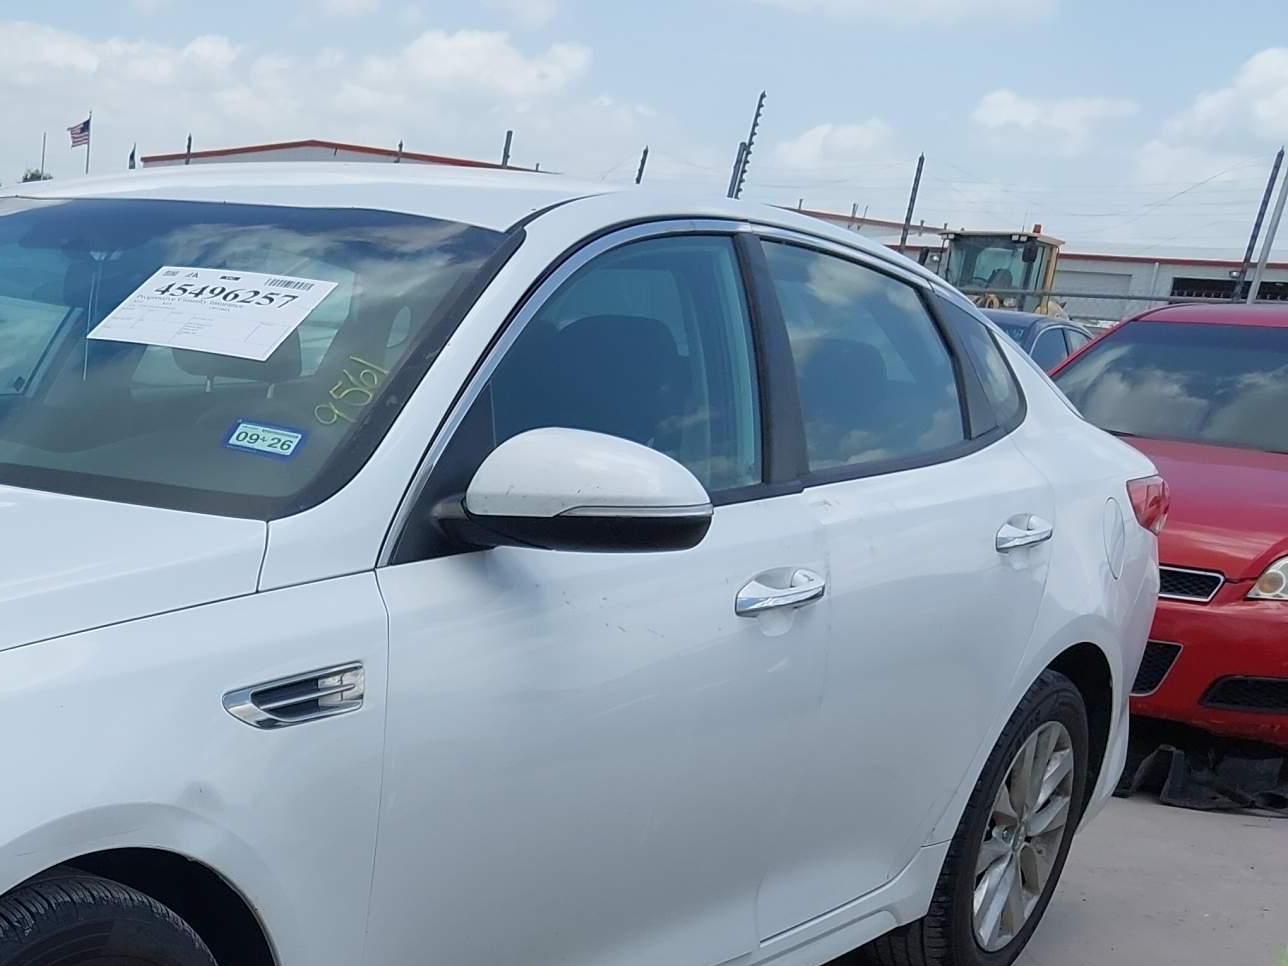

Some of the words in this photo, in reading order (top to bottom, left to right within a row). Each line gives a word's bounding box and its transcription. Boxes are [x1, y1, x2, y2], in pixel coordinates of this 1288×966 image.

[154, 282, 299, 309] 45496257
[314, 355, 389, 425] 9561
[235, 431, 260, 444] 09
[267, 437, 294, 451] 26
